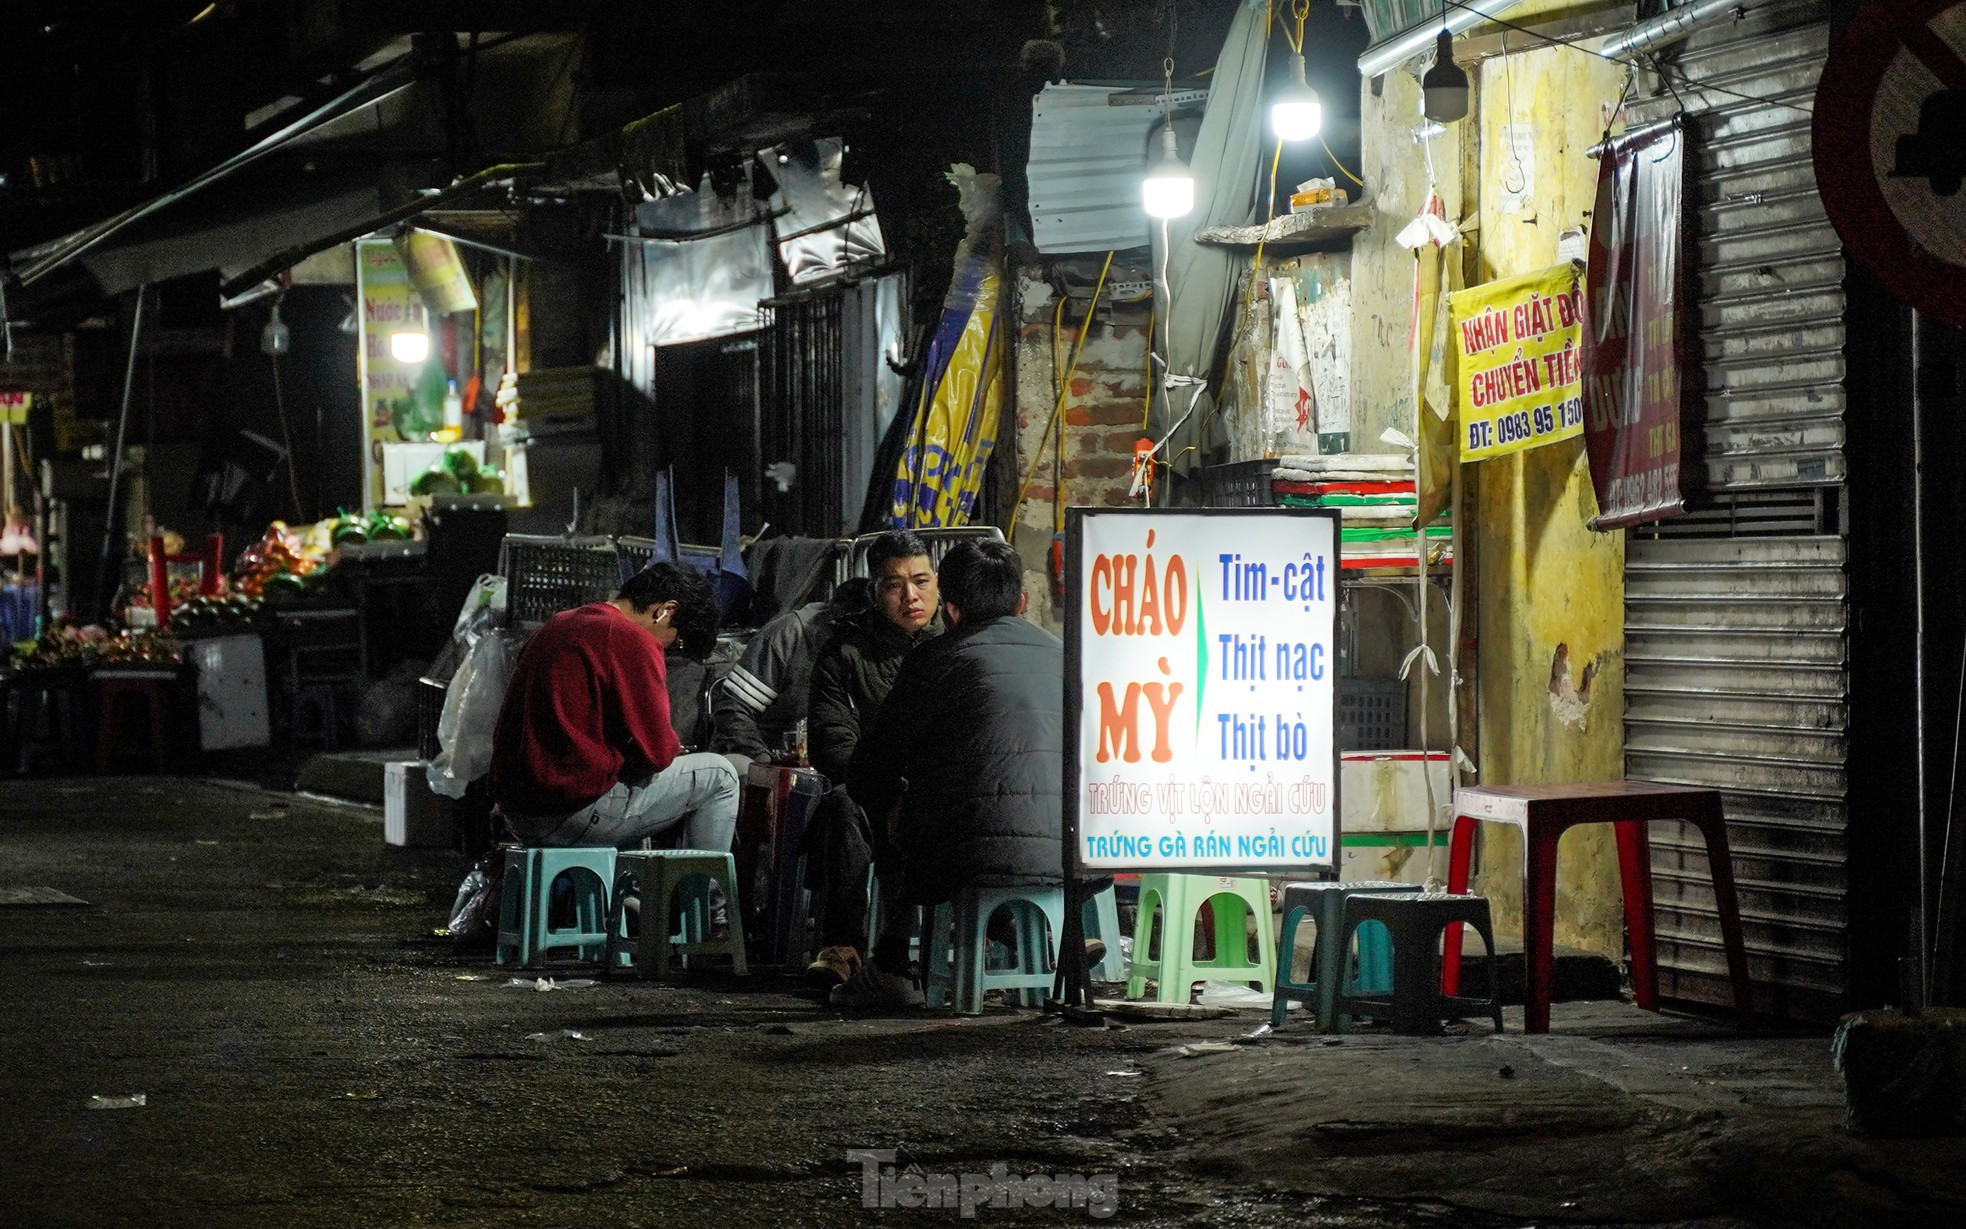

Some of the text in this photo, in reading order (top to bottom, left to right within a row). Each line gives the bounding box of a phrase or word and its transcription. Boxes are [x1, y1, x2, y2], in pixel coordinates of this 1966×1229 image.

[1462, 307, 1508, 355] NHẬN
[1513, 293, 1555, 343] GIẶT
[1472, 347, 1540, 408] CHUYỂN
[1469, 420, 1493, 450] ĐT:
[1497, 411, 1531, 444] 0983
[1534, 405, 1554, 434] 95
[1090, 529, 1188, 636] CHÁO
[1219, 553, 1325, 612] Tim-cật
[1218, 634, 1325, 692] Thịt nạc
[1096, 656, 1184, 763] MỲ
[1217, 712, 1307, 771] Thịt bò
[1089, 771, 1326, 824] TRỨNG VỊT LỘN NGẢI CỨU
[1087, 827, 1327, 857] TRỨNG GÀ RÁN NGẢI CỨU
